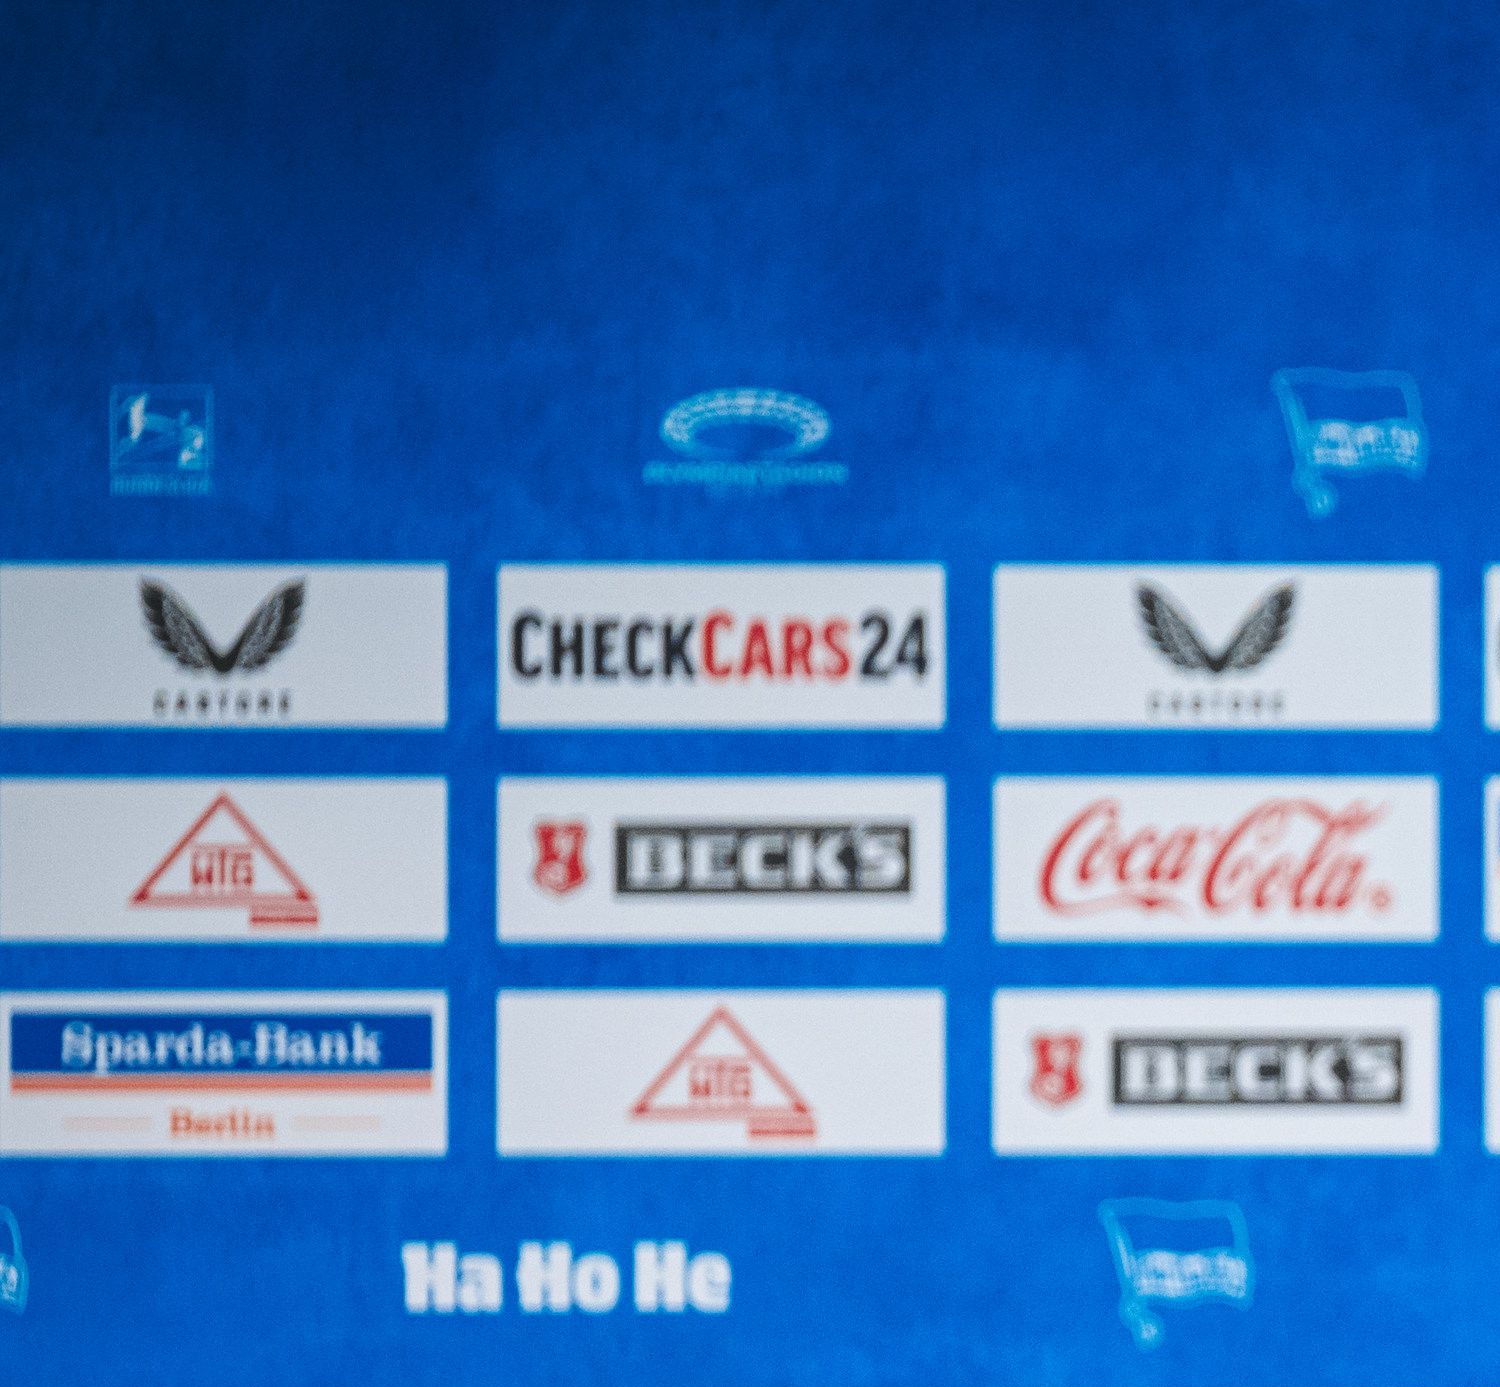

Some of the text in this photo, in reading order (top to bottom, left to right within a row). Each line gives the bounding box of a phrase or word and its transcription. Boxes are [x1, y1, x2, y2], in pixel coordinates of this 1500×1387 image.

[401, 1241, 733, 1314] Ha Ho He
